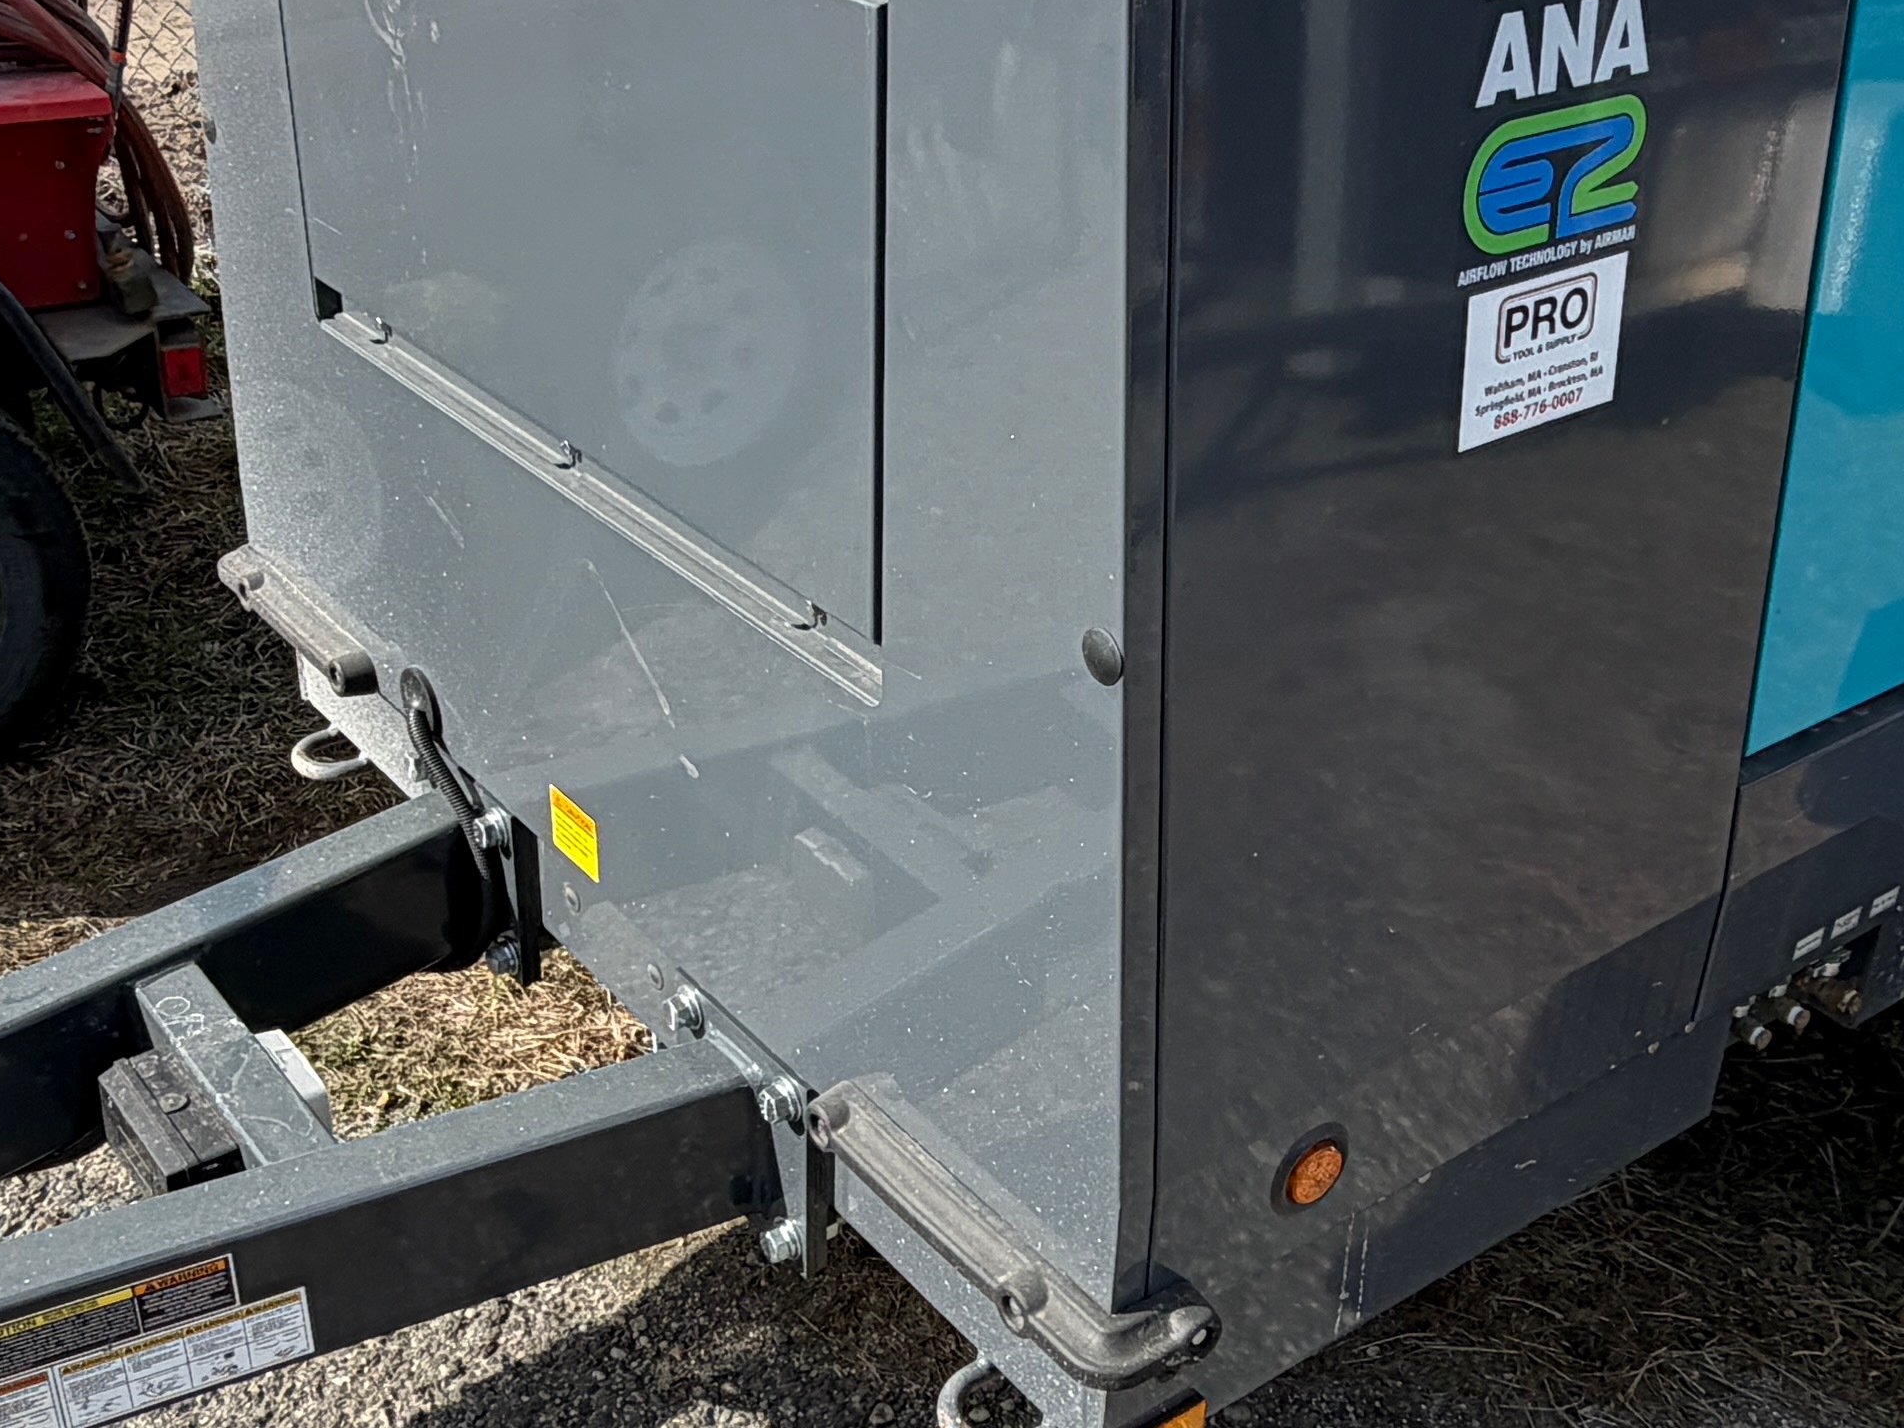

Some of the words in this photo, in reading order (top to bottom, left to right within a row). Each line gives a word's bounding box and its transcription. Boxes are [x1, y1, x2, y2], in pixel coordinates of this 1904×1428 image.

[1457, 259, 1508, 288] AIRFLOW
[1509, 240, 1578, 273] TECHNOLOGY
[1580, 238, 1594, 256] by
[1594, 224, 1637, 250] AIRMAN
[1503, 287, 1589, 349] PRO
[1493, 386, 1584, 430] 888-776-0007
[157, 1262, 220, 1289] WARNING
